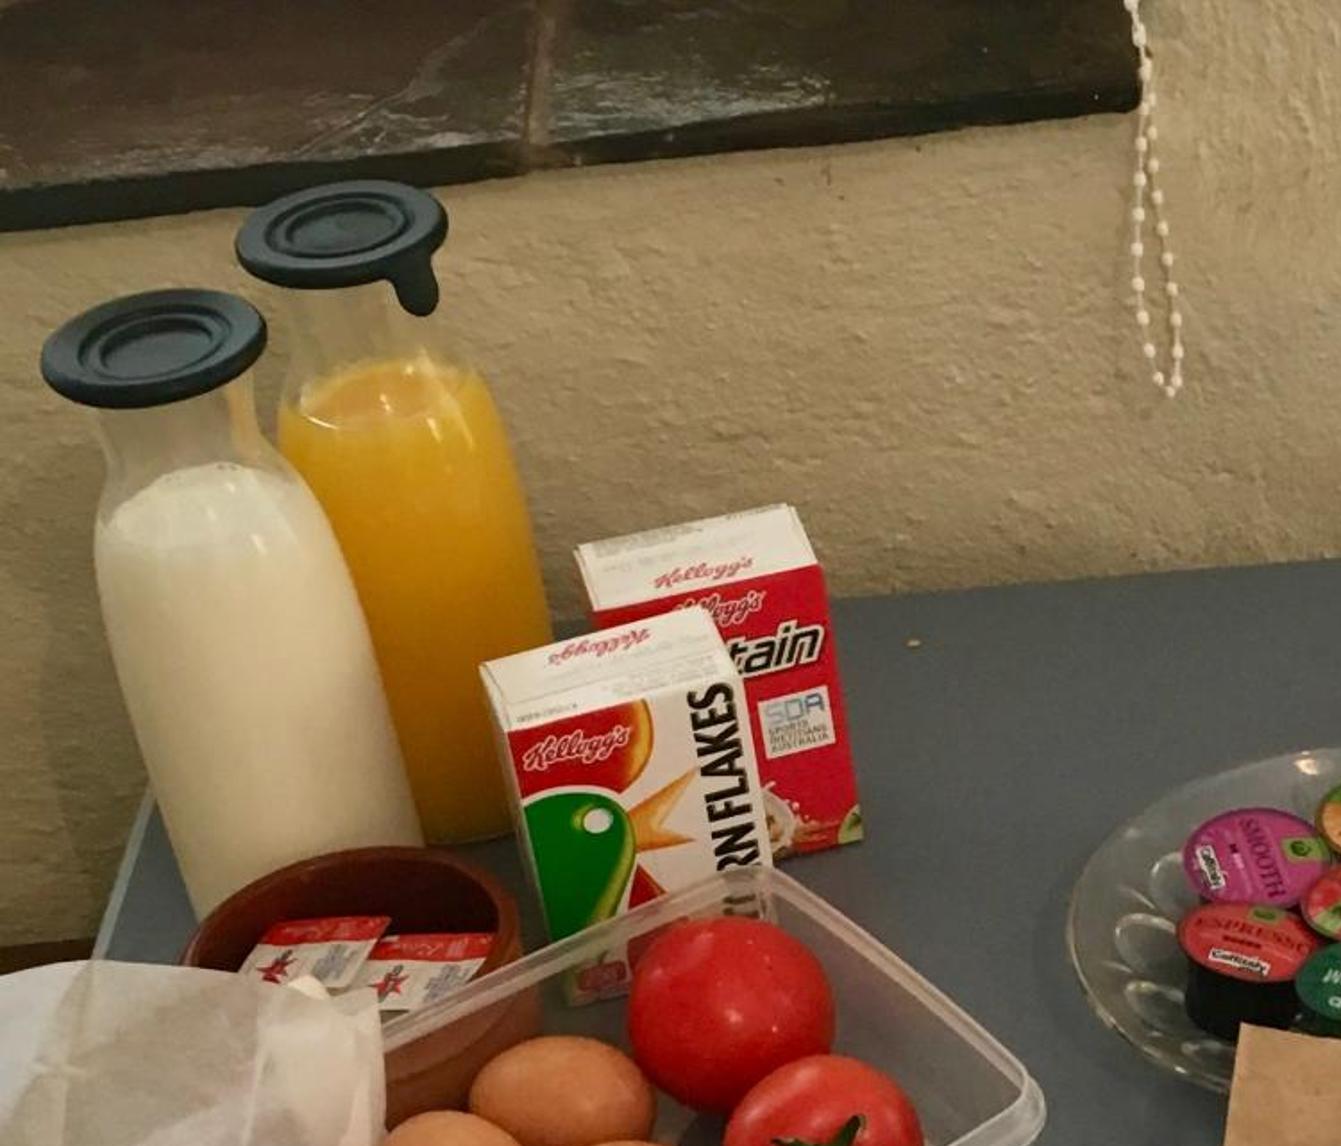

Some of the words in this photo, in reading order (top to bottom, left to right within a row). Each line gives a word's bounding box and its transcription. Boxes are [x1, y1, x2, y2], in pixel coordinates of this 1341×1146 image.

[653, 556, 754, 589] Kellogg's
[546, 628, 652, 666] Kellogg's
[522, 723, 633, 772] Kellogg's
[686, 682, 754, 823] FLAKES
[1239, 818, 1286, 898] SMOOTH
